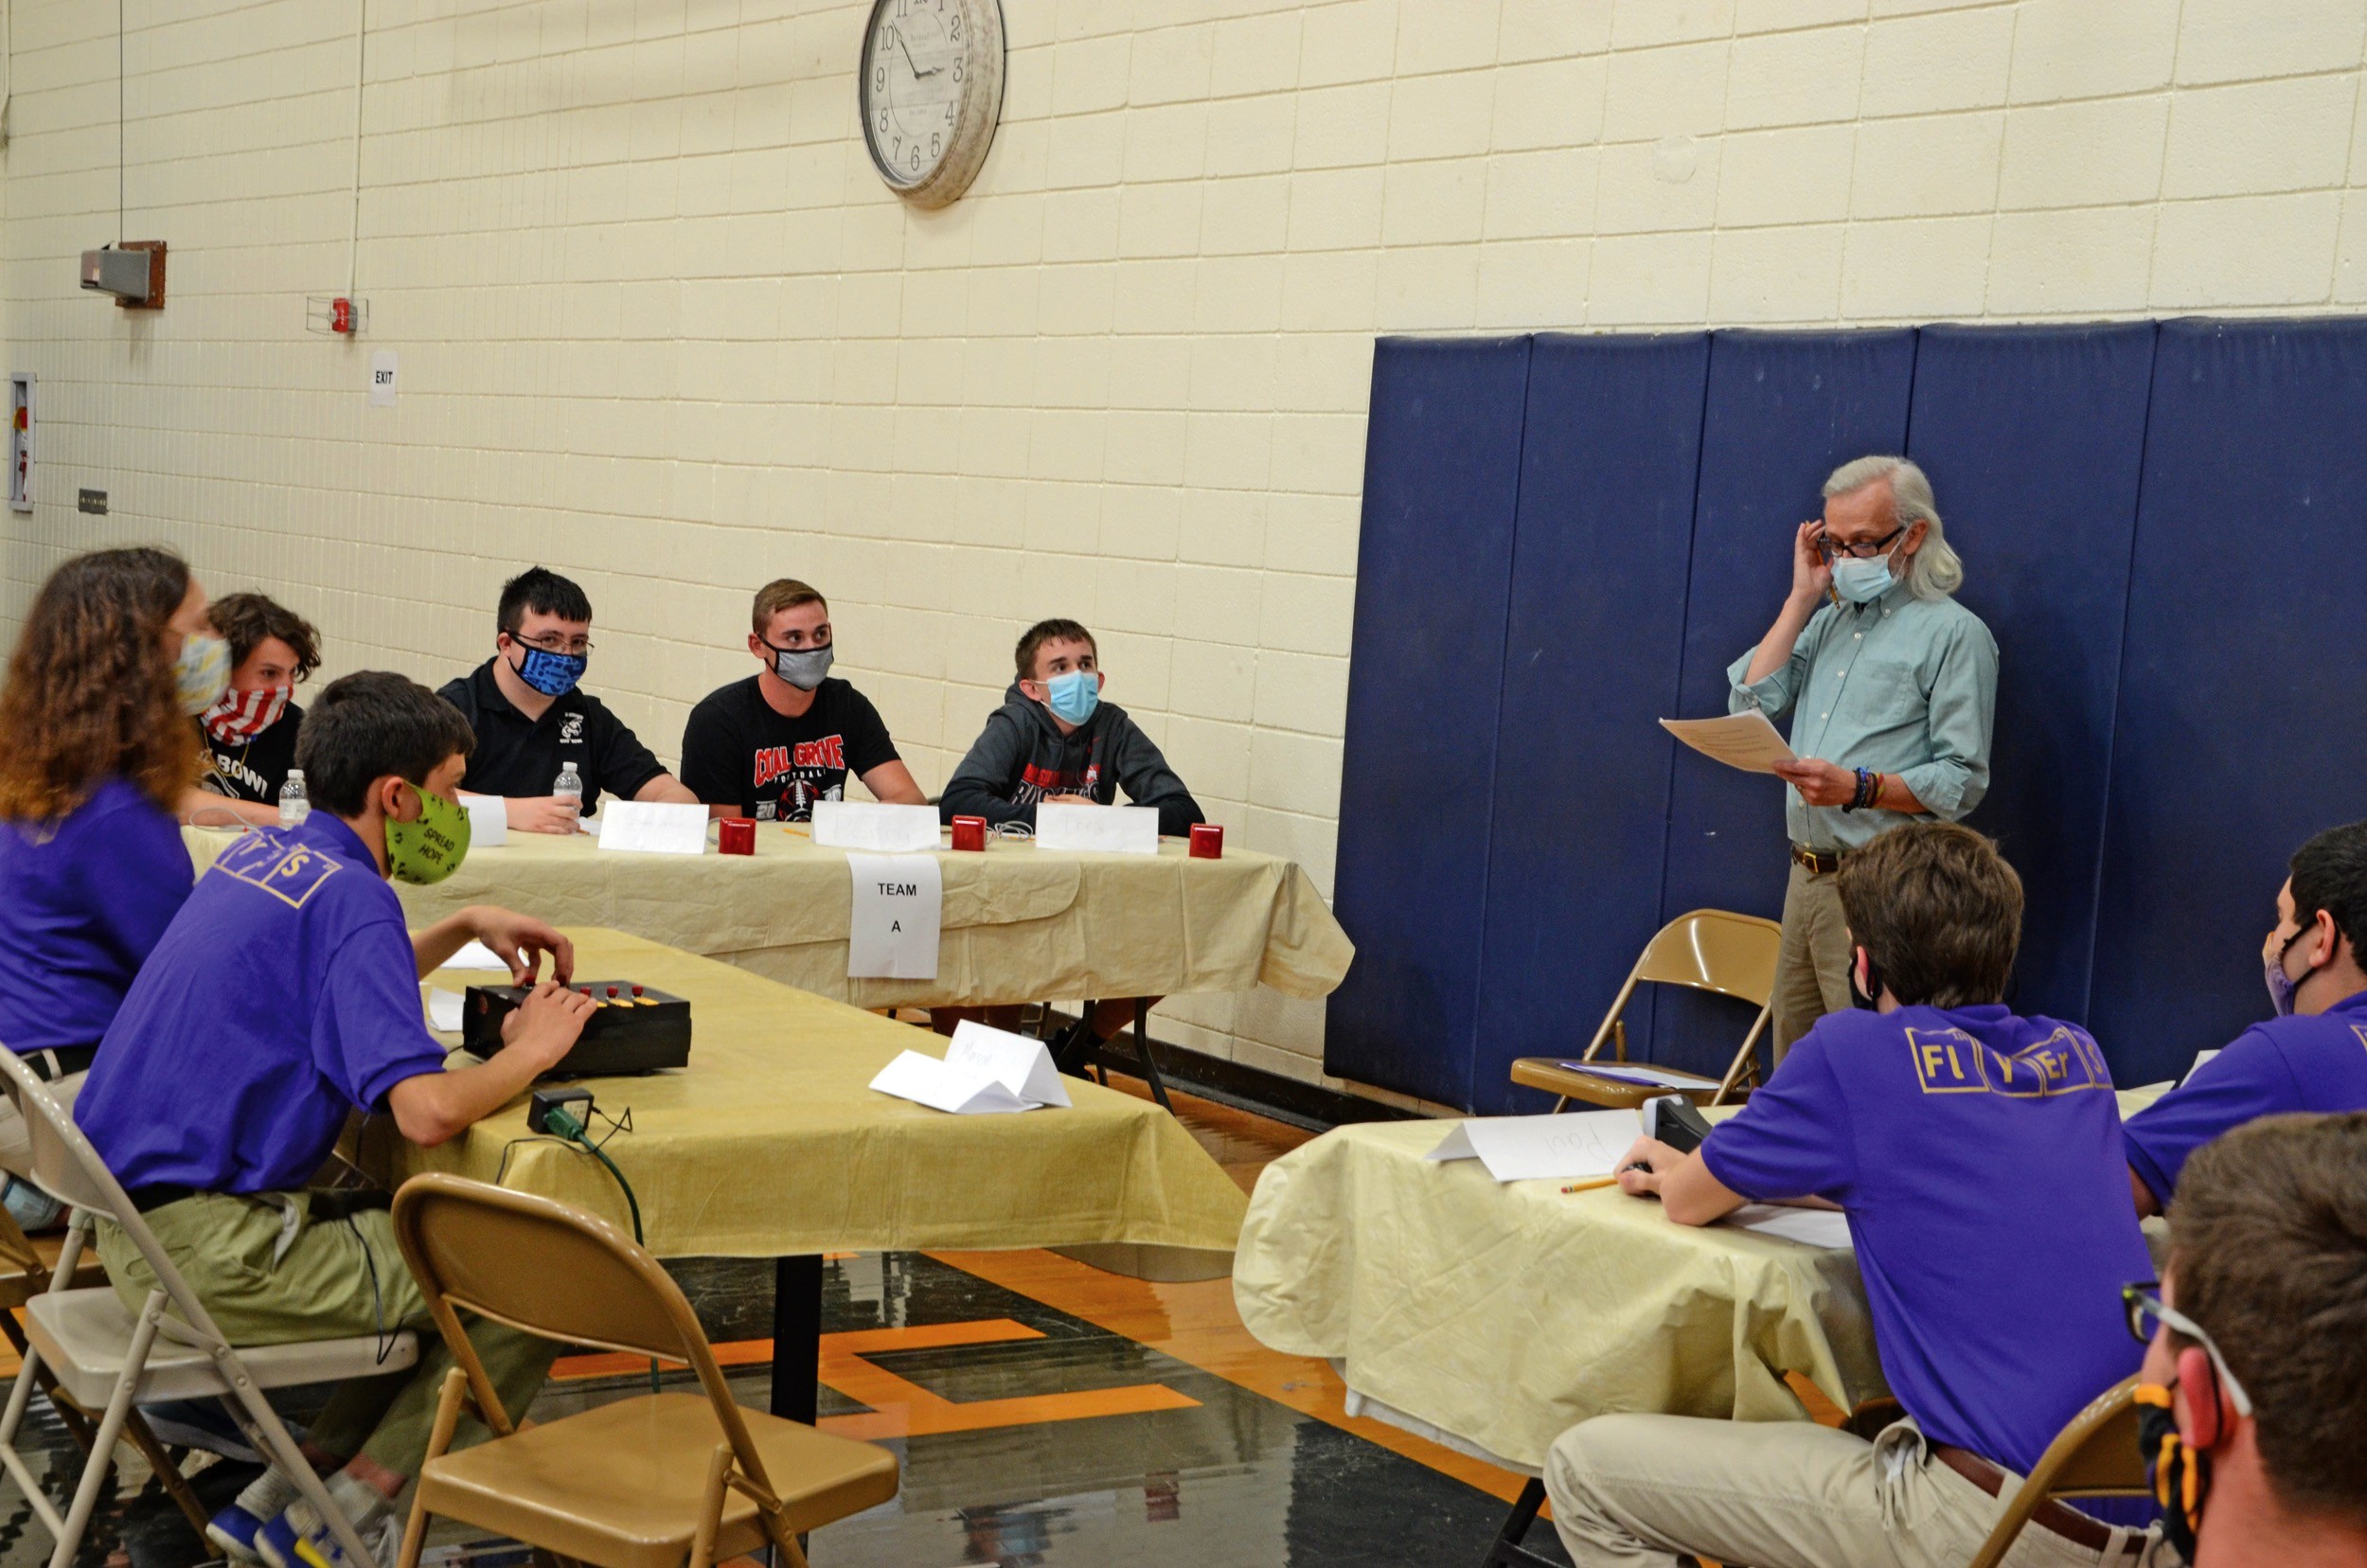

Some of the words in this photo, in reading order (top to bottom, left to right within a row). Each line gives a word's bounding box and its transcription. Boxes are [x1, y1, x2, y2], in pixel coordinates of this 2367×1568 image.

[881, 25, 895, 51] 10
[950, 14, 960, 42] 2
[876, 66, 885, 93] 9
[952, 57, 963, 82] 3
[880, 107, 888, 133] 8
[945, 100, 954, 127] 4
[892, 135, 901, 162] 7
[911, 145, 920, 171] 6
[931, 132, 940, 158] 5
[375, 370, 393, 384] EXIT
[755, 746, 792, 788] COAL
[793, 734, 845, 770] GROVE
[423, 828, 455, 851] SPREAD
[418, 845, 444, 865] HOPE
[878, 882, 917, 896] TEAM
[891, 920, 901, 933] A
